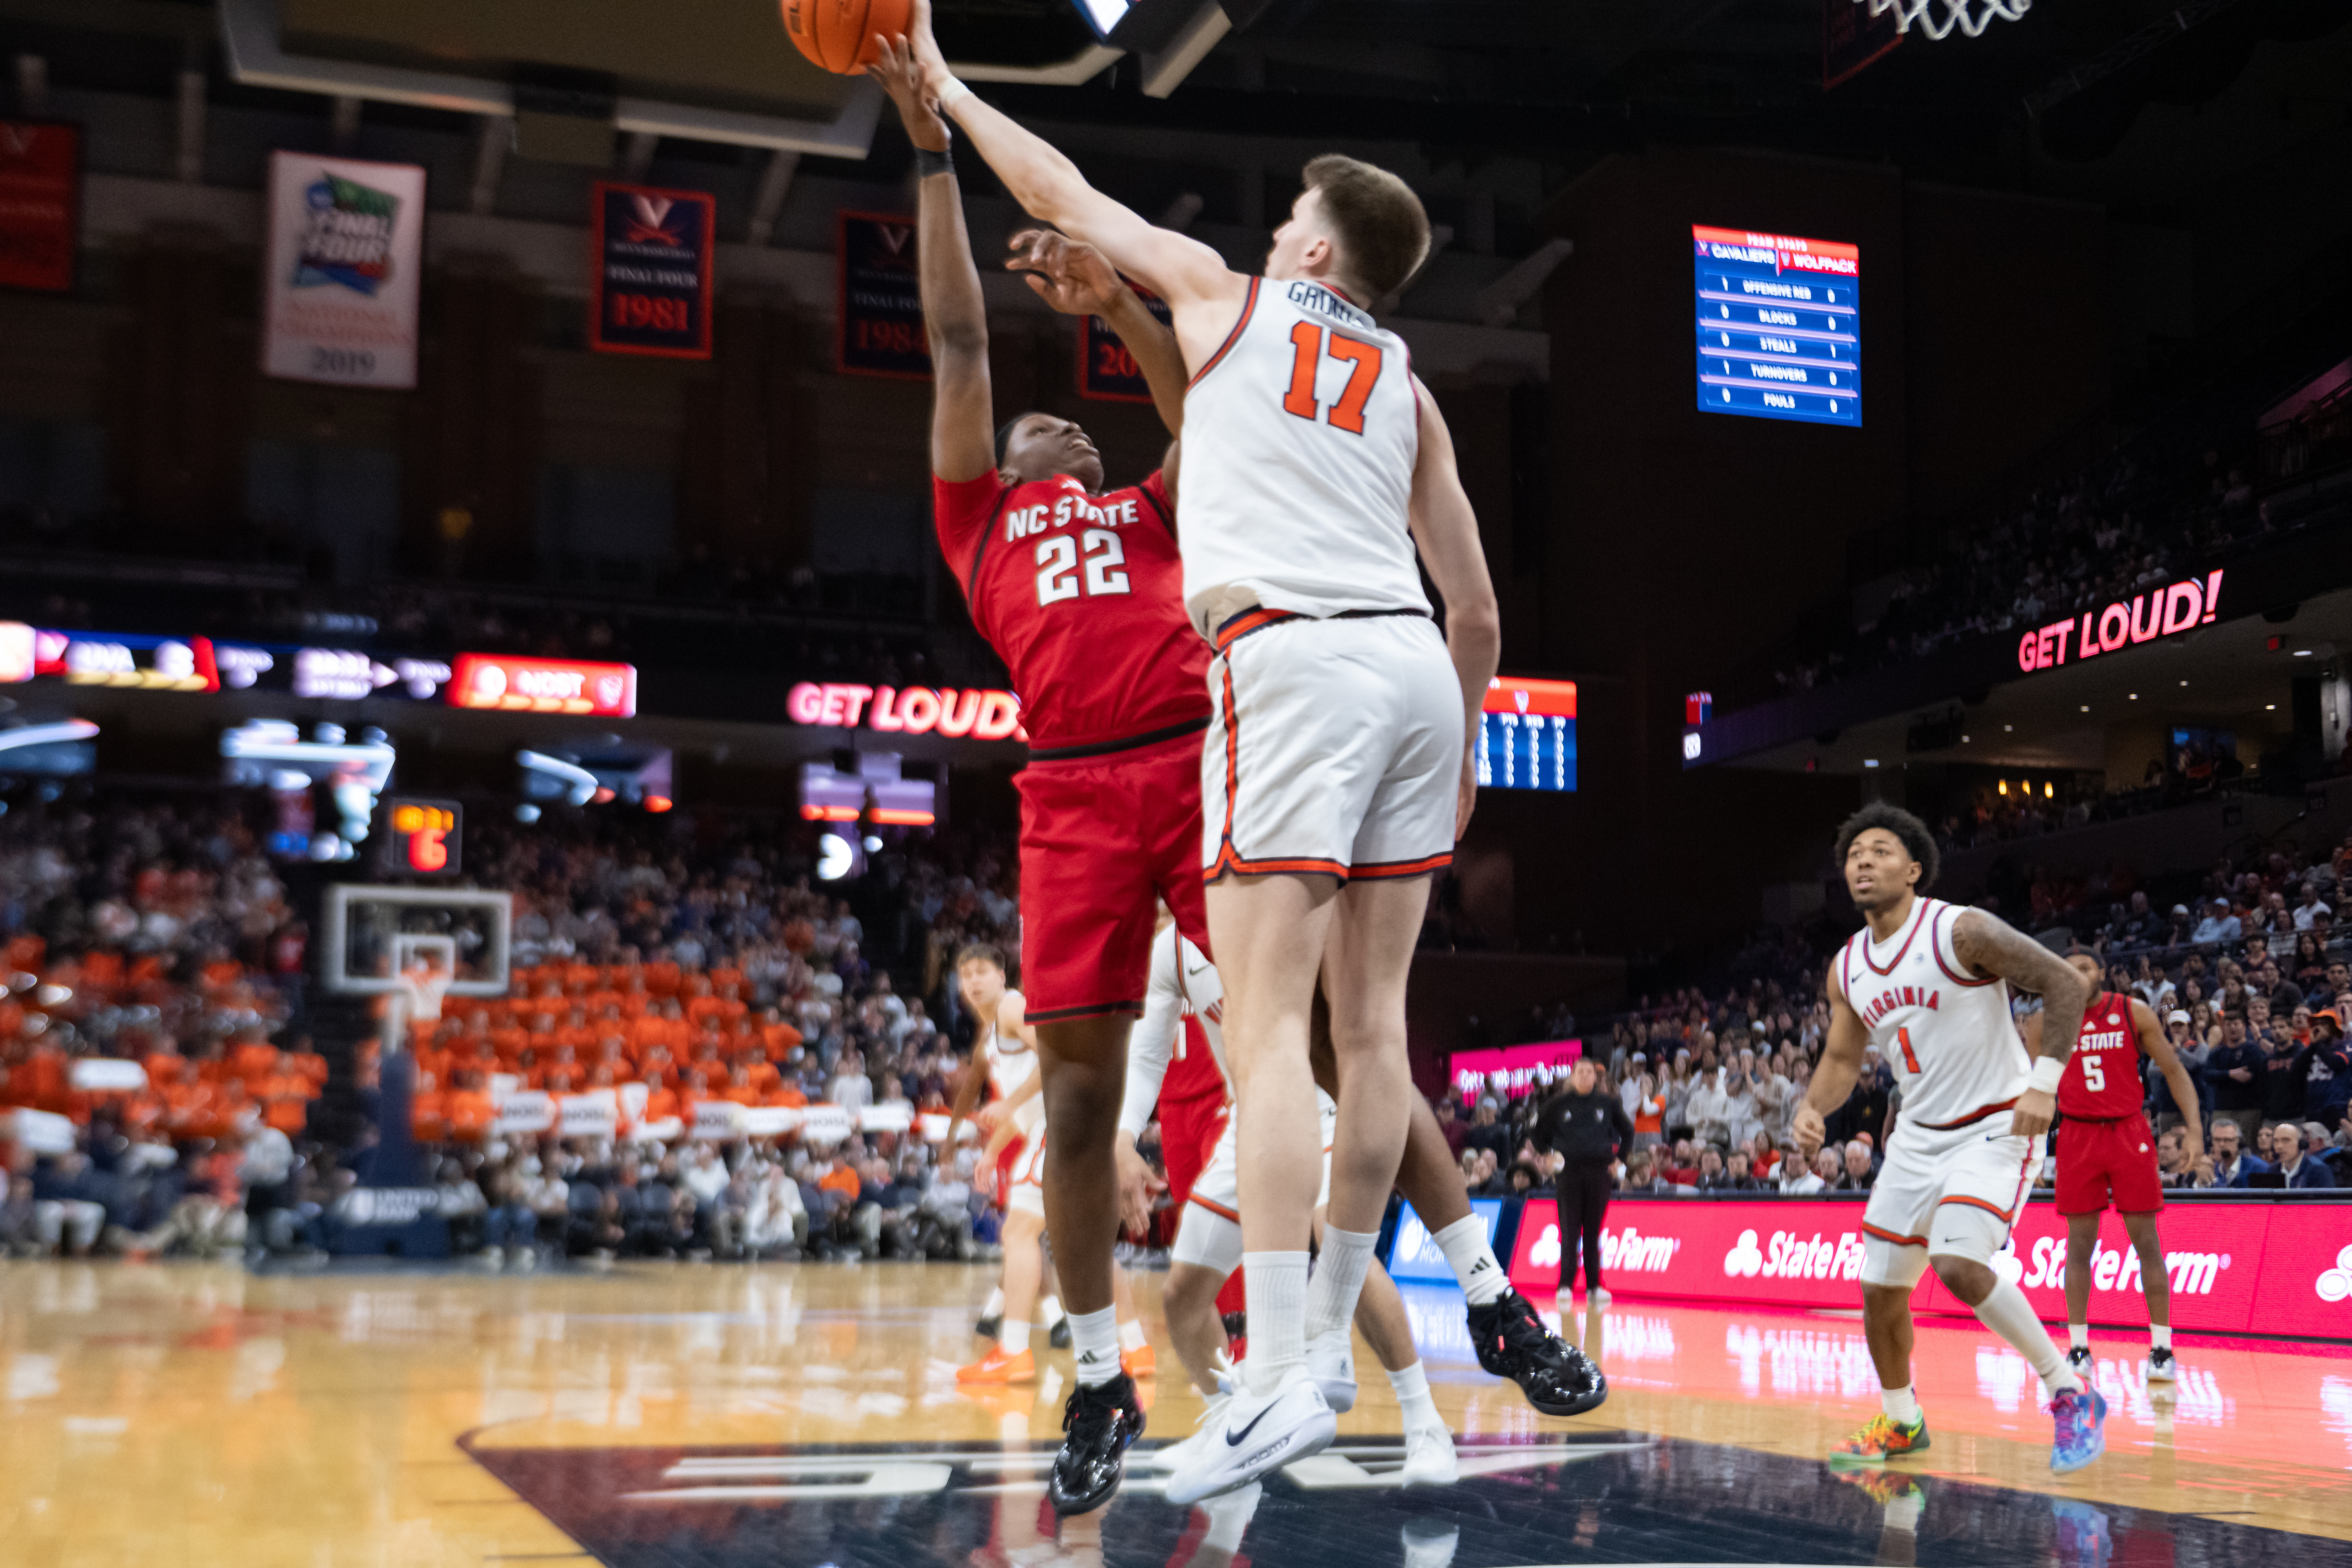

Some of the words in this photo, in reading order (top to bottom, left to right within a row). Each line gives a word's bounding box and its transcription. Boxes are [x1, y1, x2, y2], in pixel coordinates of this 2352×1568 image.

[1711, 243, 1776, 264] CAVALIERS
[1793, 253, 1857, 273] WOLFPACK
[1746, 233, 1774, 248] TEAM
[1777, 237, 1808, 252] STATS
[609, 265, 653, 282] FINAL
[657, 271, 698, 288] FOUR
[1721, 275, 1728, 291] 1
[1743, 279, 1792, 298] OFFENSIVE
[1827, 288, 1835, 303] 0
[613, 293, 689, 331] 1981
[1720, 303, 1729, 319] 0
[1758, 309, 1797, 326] BLOCKS
[1828, 316, 1836, 331] 0
[311, 347, 376, 376] 2019
[1100, 343, 1138, 378] 20
[1721, 331, 1730, 347] 0
[1760, 337, 1797, 353] STEALS
[1830, 343, 1836, 358] 1
[1284, 320, 1383, 436] 17
[1723, 359, 1730, 375] 1
[1750, 363, 1808, 383] TURNOVERS
[1829, 371, 1837, 386] 0
[1722, 387, 1731, 403] 0
[1763, 392, 1795, 409] FOULS
[1830, 399, 1838, 414] 0
[1006, 504, 1049, 542] NC
[1055, 495, 1139, 527] STATE
[1036, 528, 1131, 608] 22
[2019, 617, 2074, 673] GET
[2079, 569, 2223, 659] LOUD!
[786, 681, 873, 728] GET
[1898, 1026, 1921, 1074] 1
[2080, 1031, 2125, 1052] STATE
[2082, 1055, 2106, 1093] 5
[1763, 1230, 1867, 1280] StateFa
[2024, 1236, 2219, 1294] StteFrm
